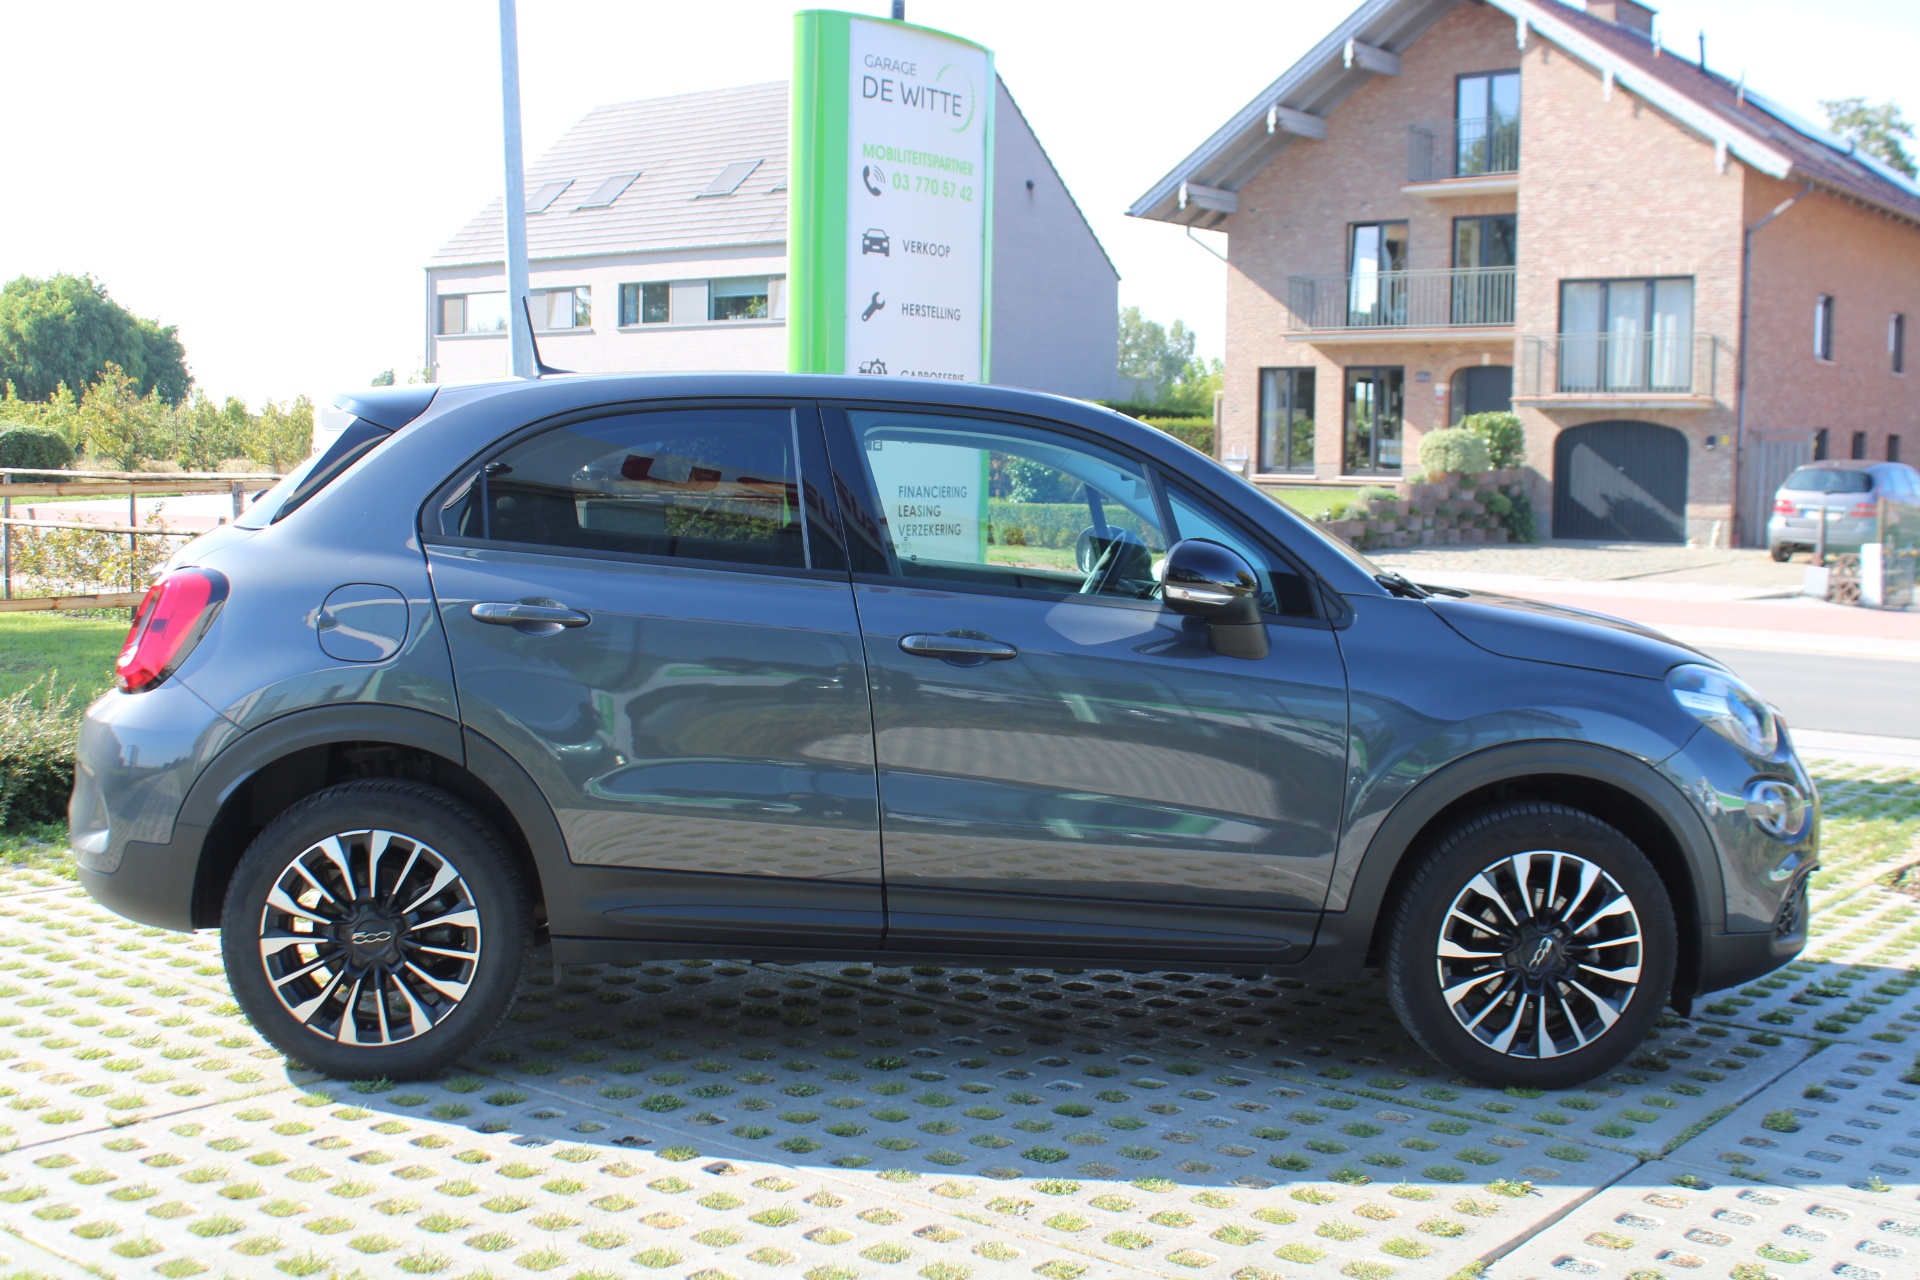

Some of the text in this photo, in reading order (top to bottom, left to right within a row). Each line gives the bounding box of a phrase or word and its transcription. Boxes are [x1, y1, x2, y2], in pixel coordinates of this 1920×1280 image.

[864, 54, 917, 76] GARAGE
[862, 75, 962, 117] DE WITTE
[862, 143, 974, 177] MOBILITEITSPARTNER
[892, 172, 973, 202] 03 770 57 42
[902, 239, 951, 258] VERKOOP
[901, 303, 962, 321] HERSTELLING
[898, 485, 968, 498] FINANCIERING
[898, 505, 941, 518] LEASING
[898, 523, 962, 537] VERZEKERING
